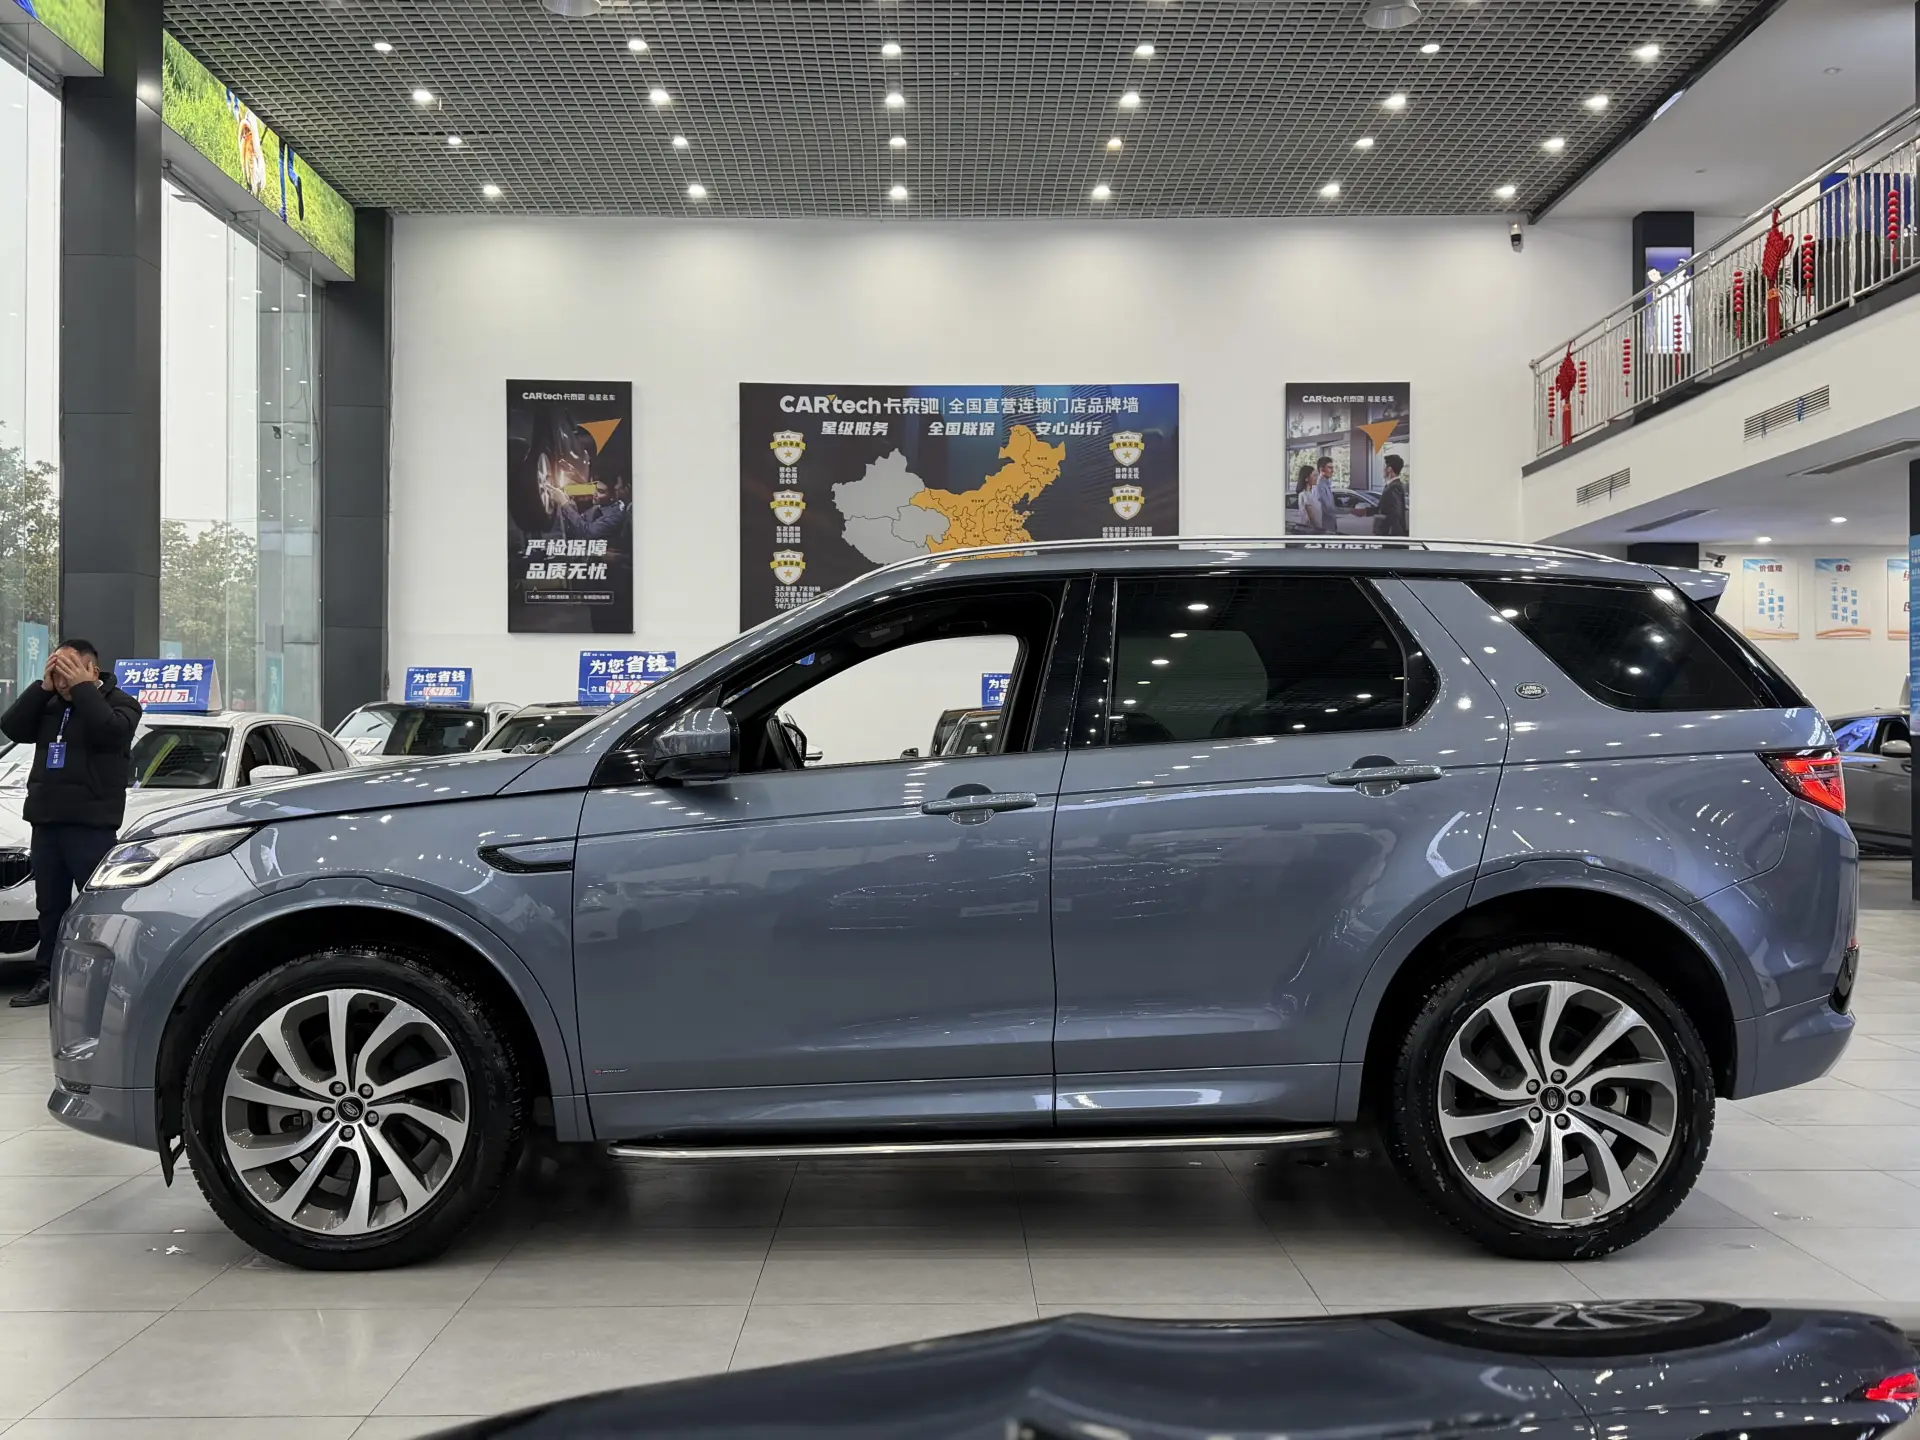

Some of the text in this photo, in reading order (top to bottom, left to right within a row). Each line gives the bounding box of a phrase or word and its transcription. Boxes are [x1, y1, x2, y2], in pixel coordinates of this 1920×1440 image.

[779, 395, 1139, 414] CARtech 卡泰驰 全国直营连锁门店品牌墙
[820, 421, 1102, 436] 星级服务 全国联保 安心出行
[525, 539, 608, 556] 严检保障
[526, 562, 608, 580] 品质无忧
[1759, 564, 1783, 572] 价值观
[589, 654, 670, 675] 为您省钱
[122, 663, 203, 684] 为您省钱
[413, 670, 466, 683] 为您省钱
